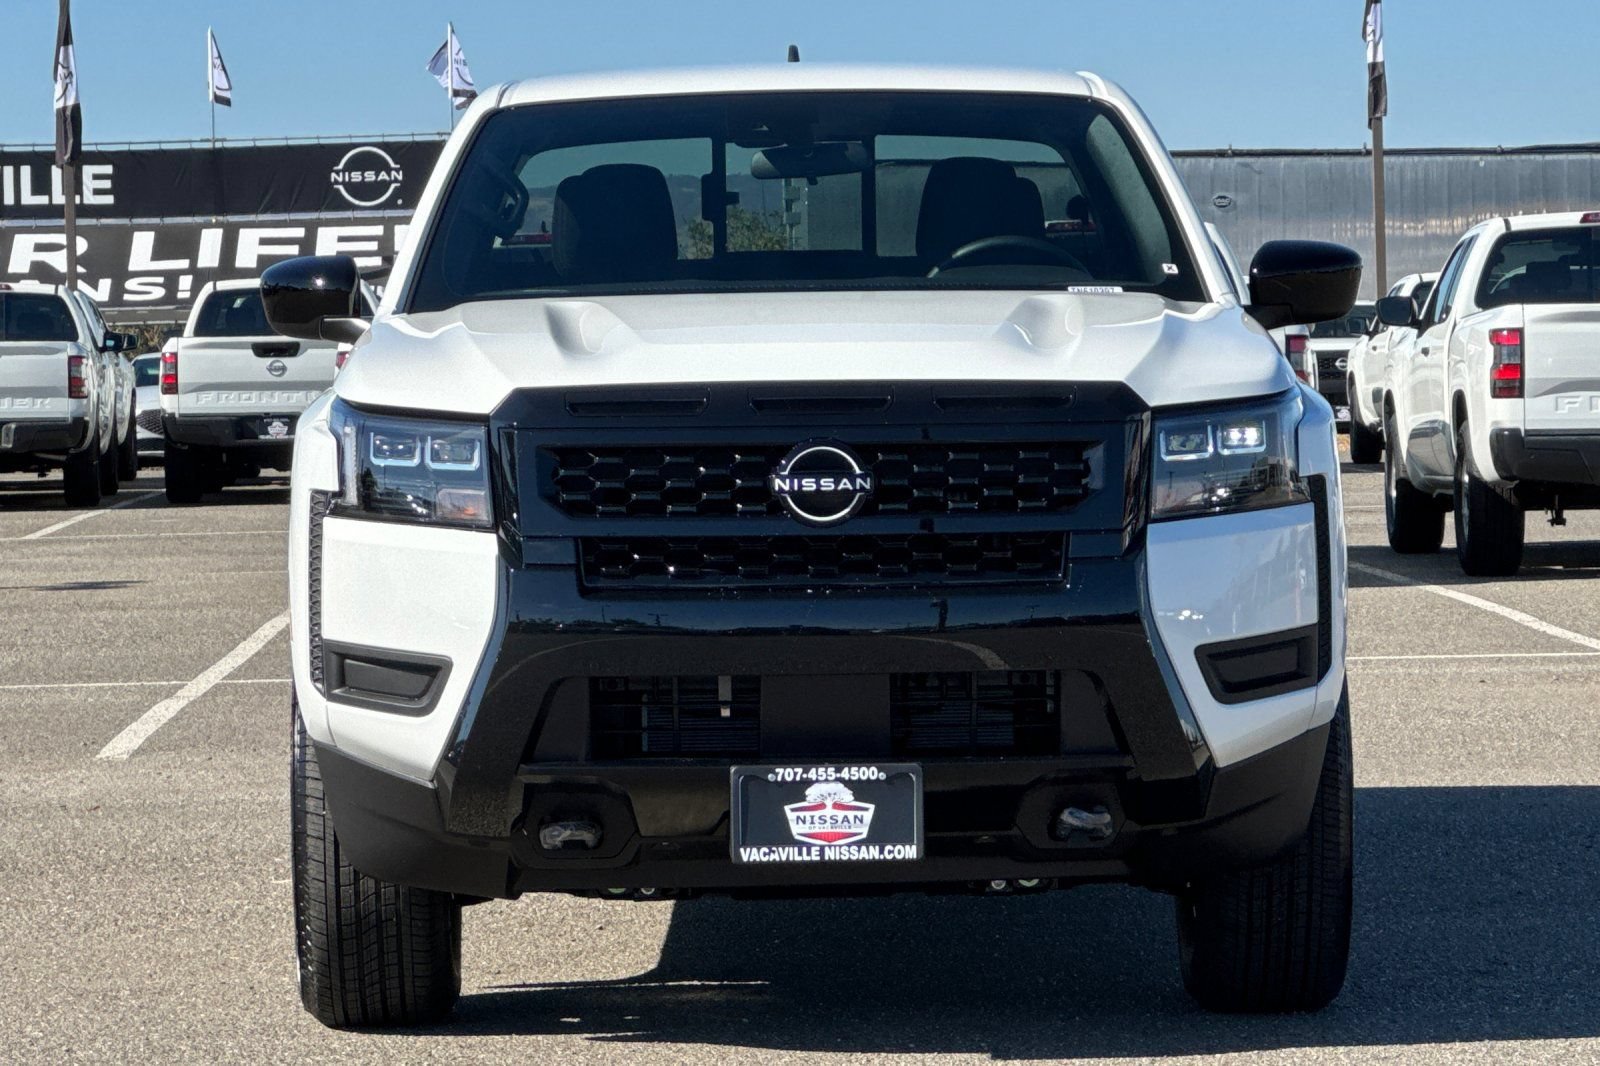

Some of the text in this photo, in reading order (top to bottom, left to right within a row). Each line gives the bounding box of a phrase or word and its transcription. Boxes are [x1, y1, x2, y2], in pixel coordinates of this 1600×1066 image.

[331, 169, 403, 184] NISSAN
[774, 477, 871, 491] NISSAN
[775, 766, 878, 782] 707-455-4500
[795, 814, 864, 825] NISSAN
[740, 844, 917, 862] VACAVILLE NISSAN.COM
